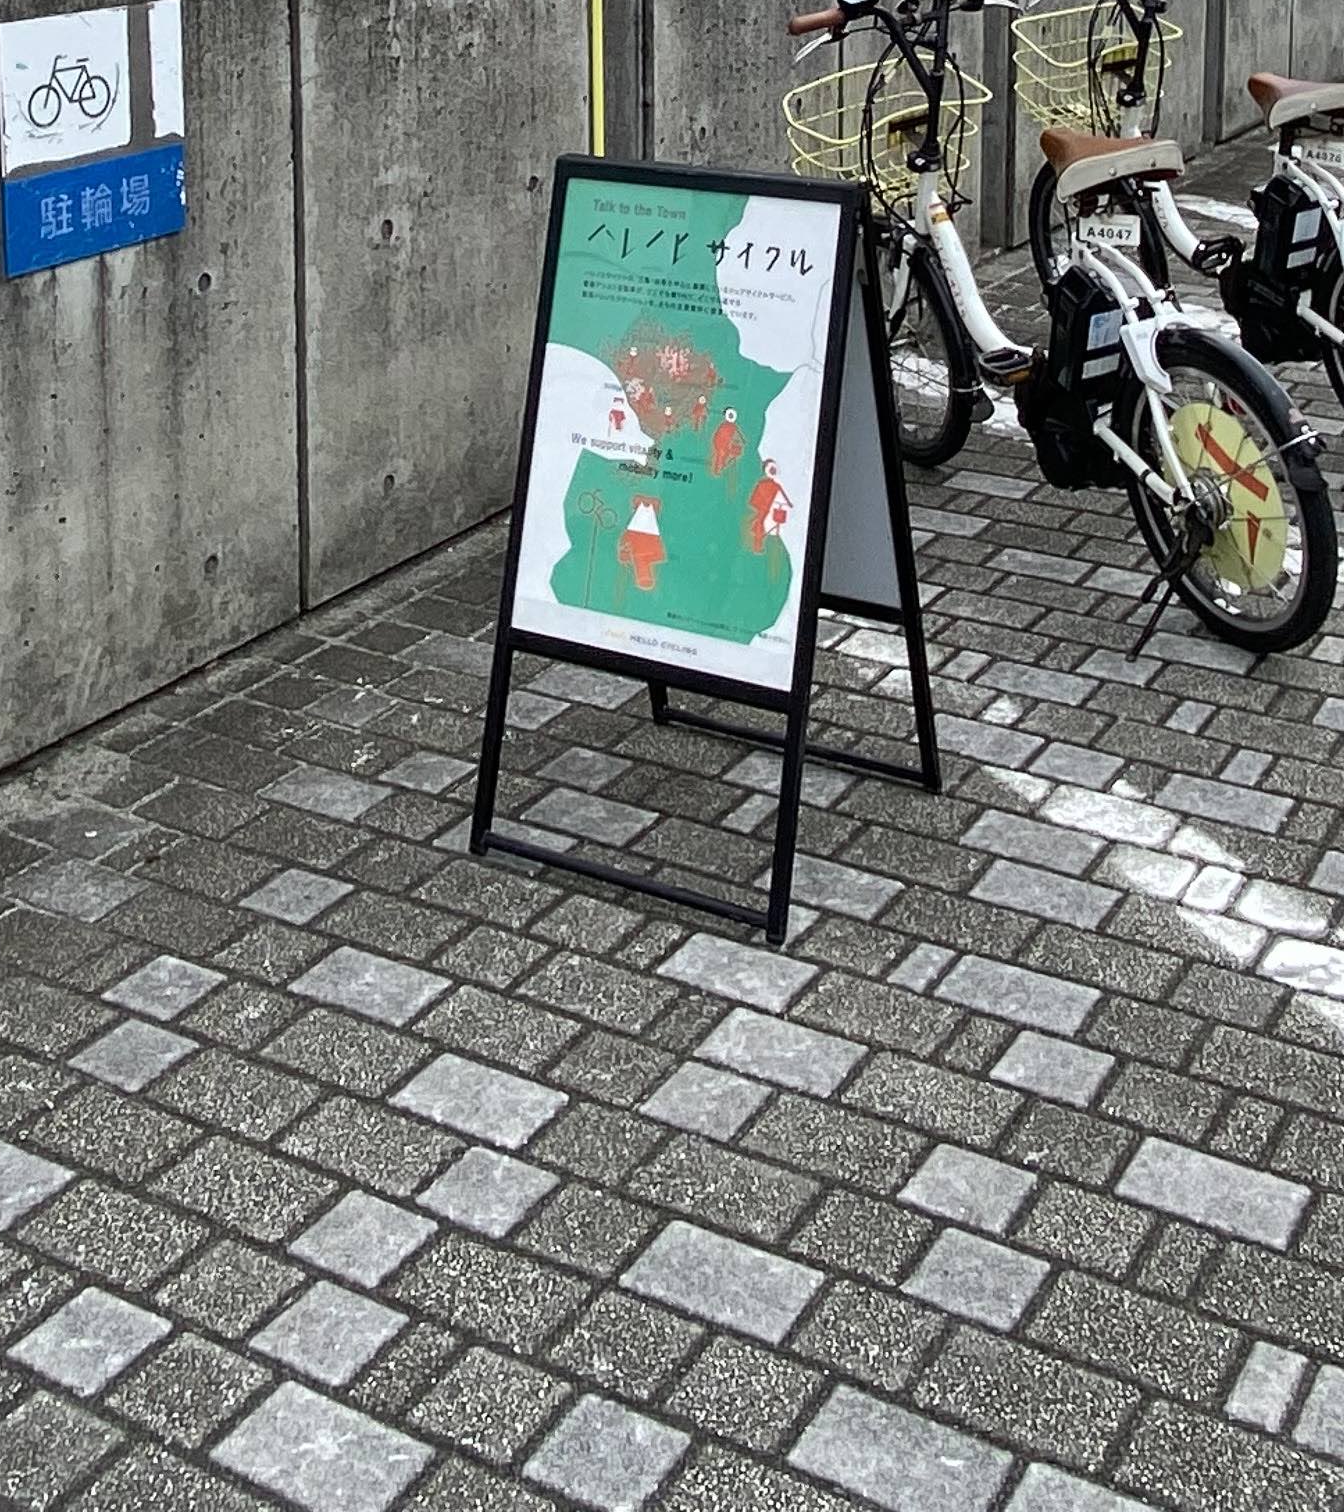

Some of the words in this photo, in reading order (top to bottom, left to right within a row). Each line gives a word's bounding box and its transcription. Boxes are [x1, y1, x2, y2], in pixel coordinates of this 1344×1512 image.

[40, 174, 151, 240] 駐輪場
[593, 198, 616, 214] Talk
[618, 201, 631, 216] to
[634, 203, 653, 218] the
[657, 205, 688, 221] Town
[1087, 226, 1133, 241] A4047
[706, 239, 814, 276] サイクル
[571, 432, 587, 446] We
[590, 438, 627, 453] support
[665, 448, 674, 461] &
[662, 470, 694, 484] more!
[629, 634, 658, 647] HELLO
